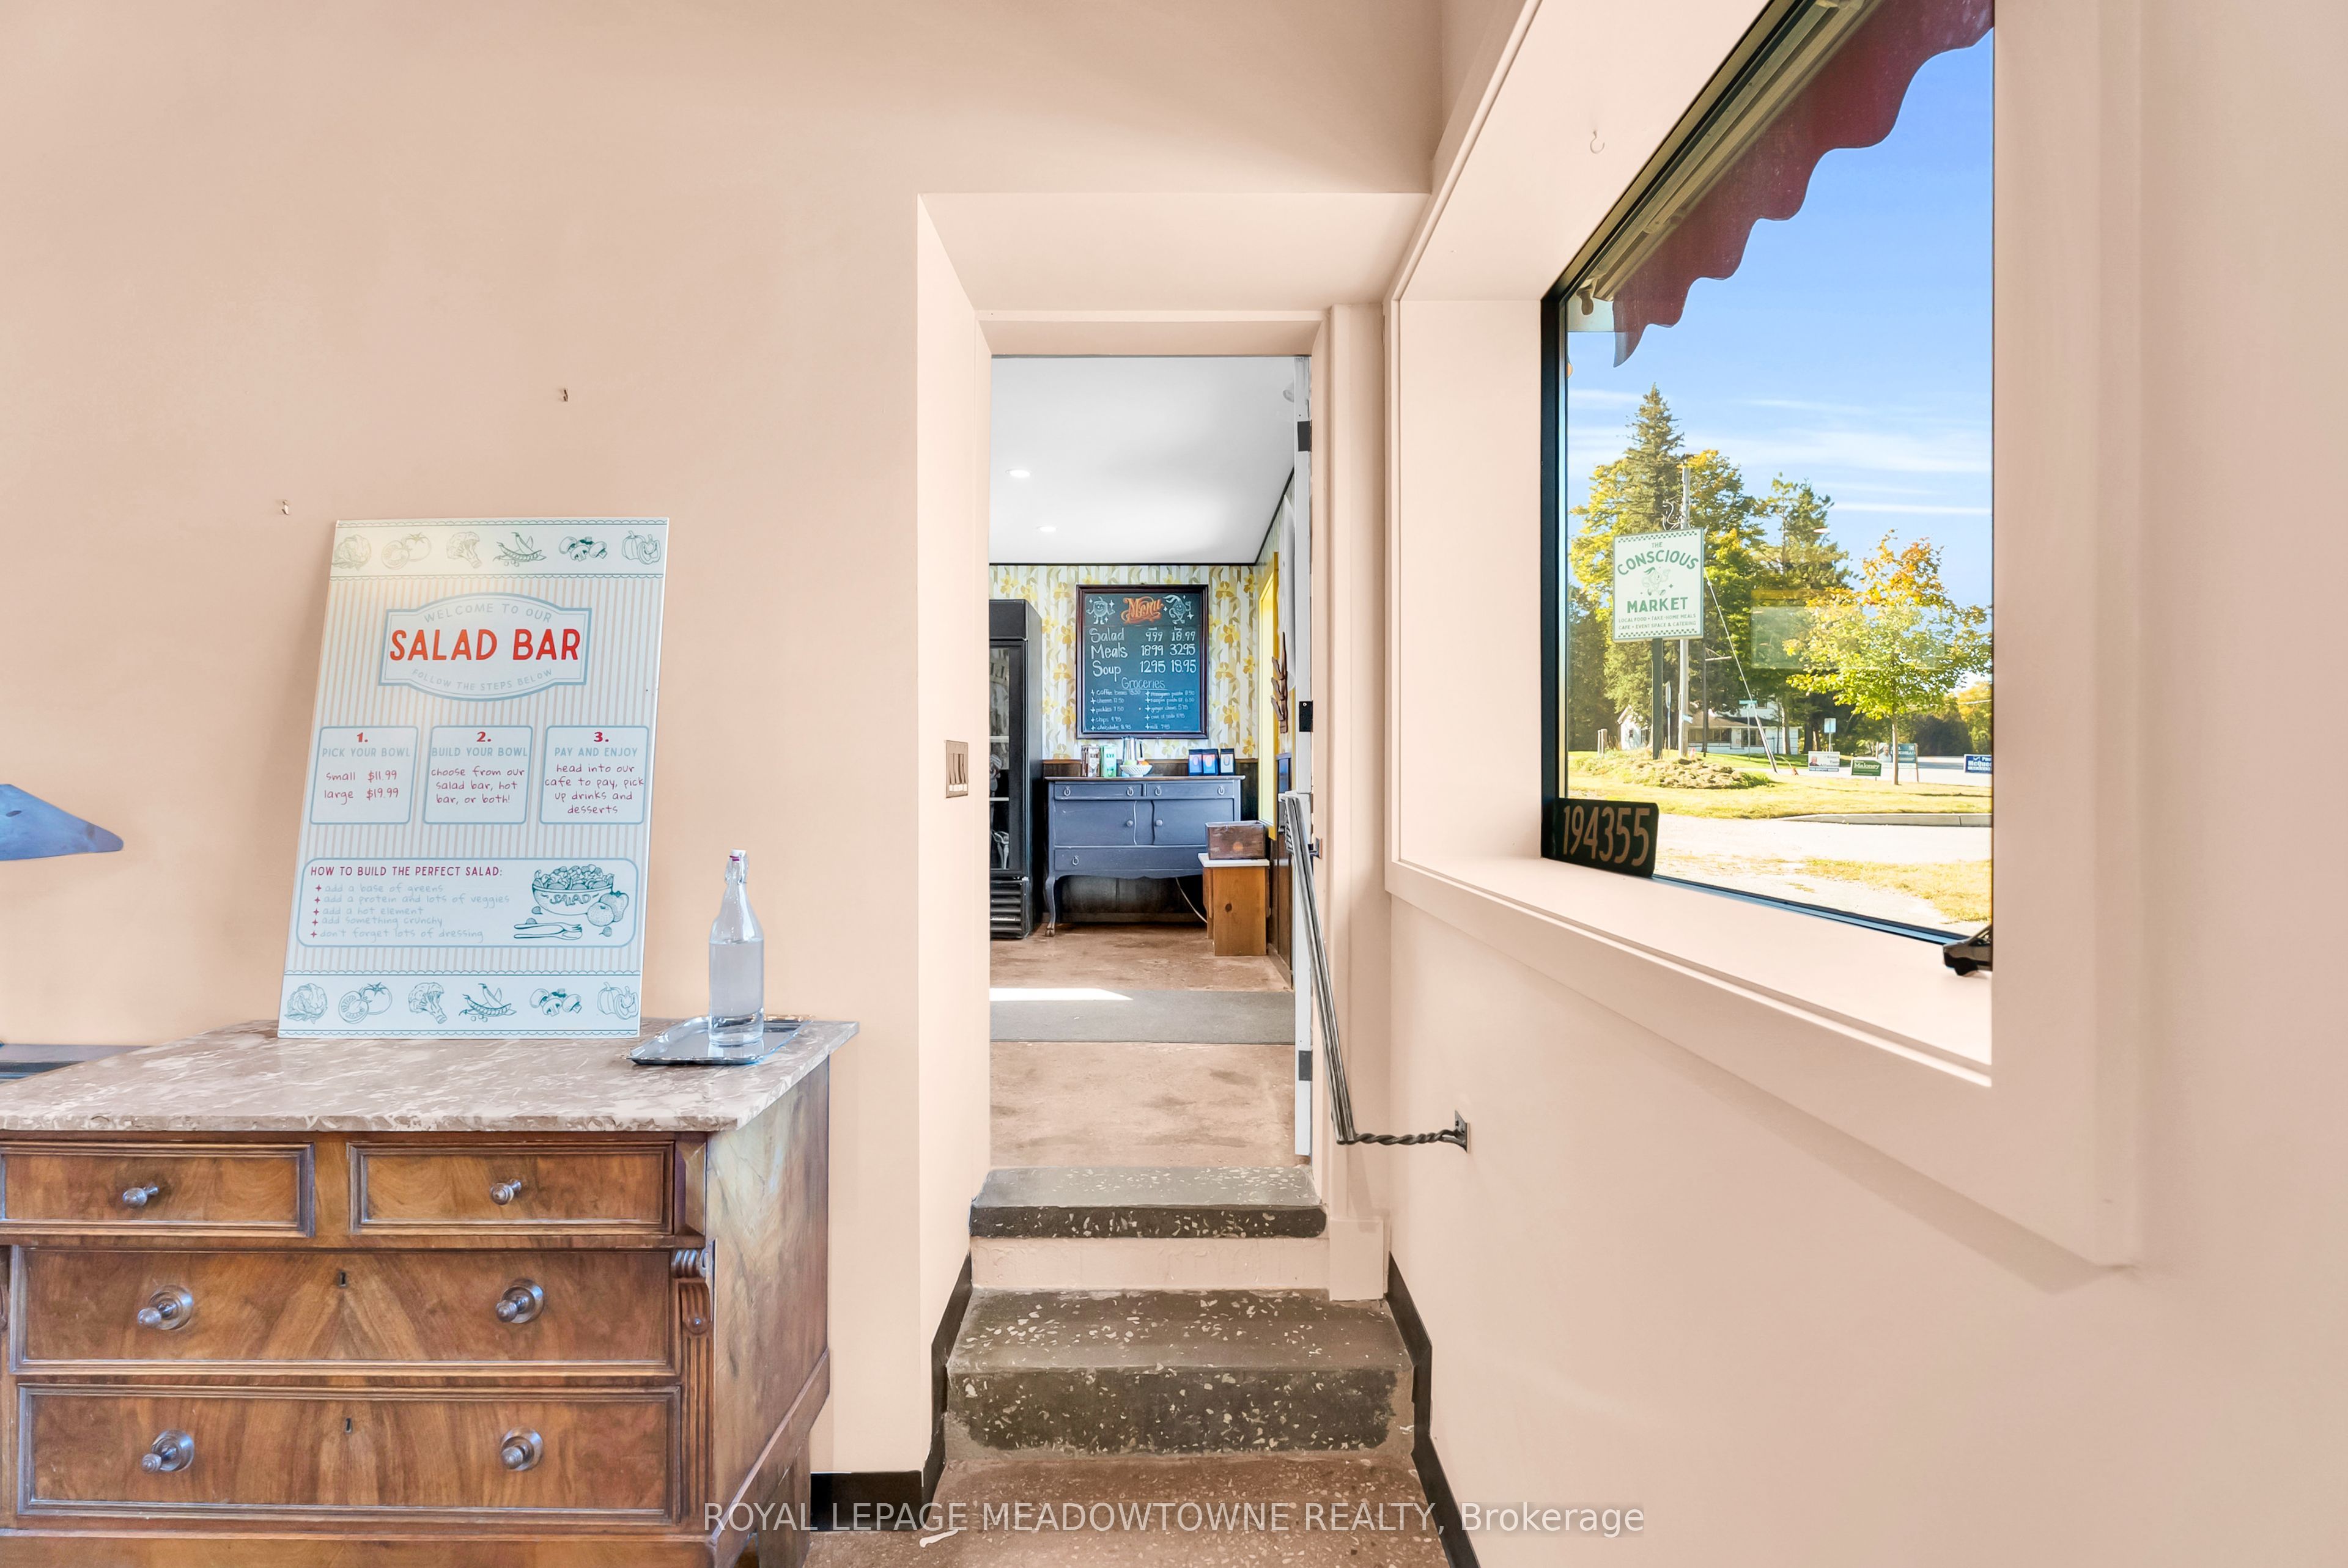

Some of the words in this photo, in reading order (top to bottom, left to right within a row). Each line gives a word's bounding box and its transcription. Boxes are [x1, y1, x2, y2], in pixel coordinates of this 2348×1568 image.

[1617, 550, 1699, 575] CONSCIOUS
[1121, 596, 1164, 624] Menu
[1627, 597, 1688, 613] MARKET
[424, 603, 494, 623] WELCOME
[501, 603, 519, 614] TO
[526, 608, 552, 623] OUR
[1089, 627, 1124, 643] Salad
[1172, 631, 1195, 641] 18.99
[389, 629, 498, 661] SALAD
[512, 629, 580, 661] BAR
[1091, 642, 1128, 659] Meals
[1092, 660, 1121, 682] Soup
[412, 669, 451, 688] FOLLOW
[457, 682, 476, 691] THE
[481, 682, 512, 691] STEPS
[517, 668, 552, 685] BELOW
[1121, 677, 1165, 690] Groceries
[356, 732, 368, 743] 1.
[476, 731, 492, 742] 2.
[594, 732, 609, 742] 3.
[322, 748, 345, 757] PICK
[351, 748, 376, 757] YOUR
[381, 748, 410, 757] BOWL
[432, 748, 460, 757] BUILD
[467, 748, 493, 757] YOUR
[498, 748, 528, 757] BOWL
[555, 748, 573, 757] PAY
[578, 748, 599, 757] AND
[604, 748, 638, 757] ENJOY
[431, 768, 465, 776] choose
[473, 765, 501, 777] from
[556, 764, 582, 773] head
[588, 764, 611, 772] into
[326, 771, 355, 781] small
[368, 770, 397, 781] $11.99
[436, 781, 465, 790] salad
[471, 780, 493, 791] bar,
[499, 781, 518, 789] hot
[545, 776, 571, 787] cafe
[578, 778, 591, 786] to
[597, 780, 618, 790] pay,
[624, 777, 644, 789] pick
[324, 790, 353, 805] large
[367, 788, 399, 800] $19.99
[436, 793, 459, 805] bar,
[482, 793, 510, 803] both!
[555, 793, 566, 802] up
[572, 790, 607, 800] drinks
[612, 792, 632, 800] and
[567, 804, 618, 814] desserts
[1563, 805, 1650, 866] 194355
[311, 866, 334, 876] HOW
[340, 866, 352, 876] TO
[358, 866, 386, 876] BUILD
[392, 866, 410, 876] THE
[415, 866, 460, 876] PERFECT
[465, 866, 503, 876] SALAD:
[360, 883, 384, 892] base
[389, 882, 404, 893] of
[407, 885, 443, 897] greens
[359, 895, 397, 904] protein
[452, 893, 466, 904] of
[471, 895, 509, 909] veggies
[550, 894, 591, 906] SALAD
[346, 916, 399, 929] something
[404, 917, 443, 927] crunchy
[353, 927, 389, 943] forget
[394, 929, 415, 937] lots
[421, 927, 434, 938] of
[438, 929, 484, 943] dressing
